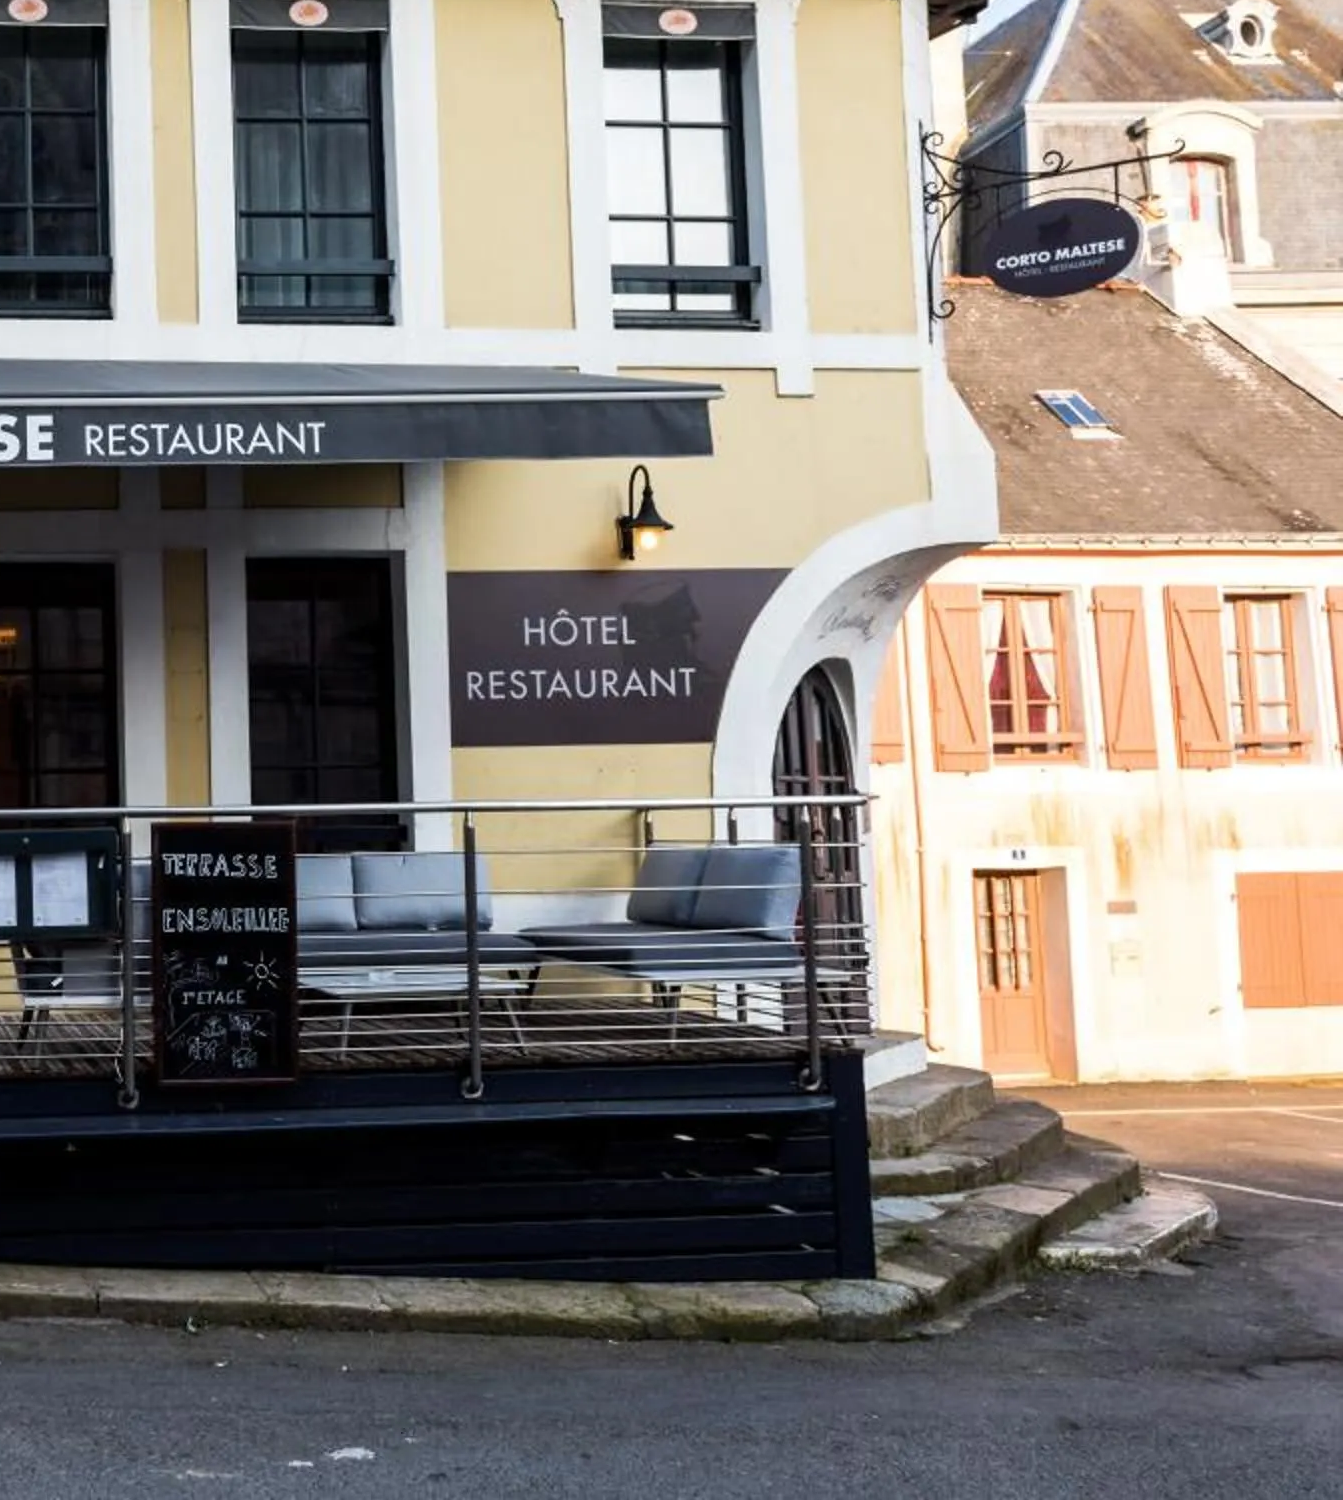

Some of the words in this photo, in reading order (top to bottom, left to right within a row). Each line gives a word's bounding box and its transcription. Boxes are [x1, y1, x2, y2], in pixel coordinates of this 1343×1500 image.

[996, 251, 1051, 269] CORTO
[1055, 238, 1125, 260] MALTESE
[84, 423, 325, 457] RESTAURANT
[525, 609, 636, 646] HÔTEL
[467, 668, 696, 700] RESTAURANT
[162, 854, 278, 879] TERRASSE
